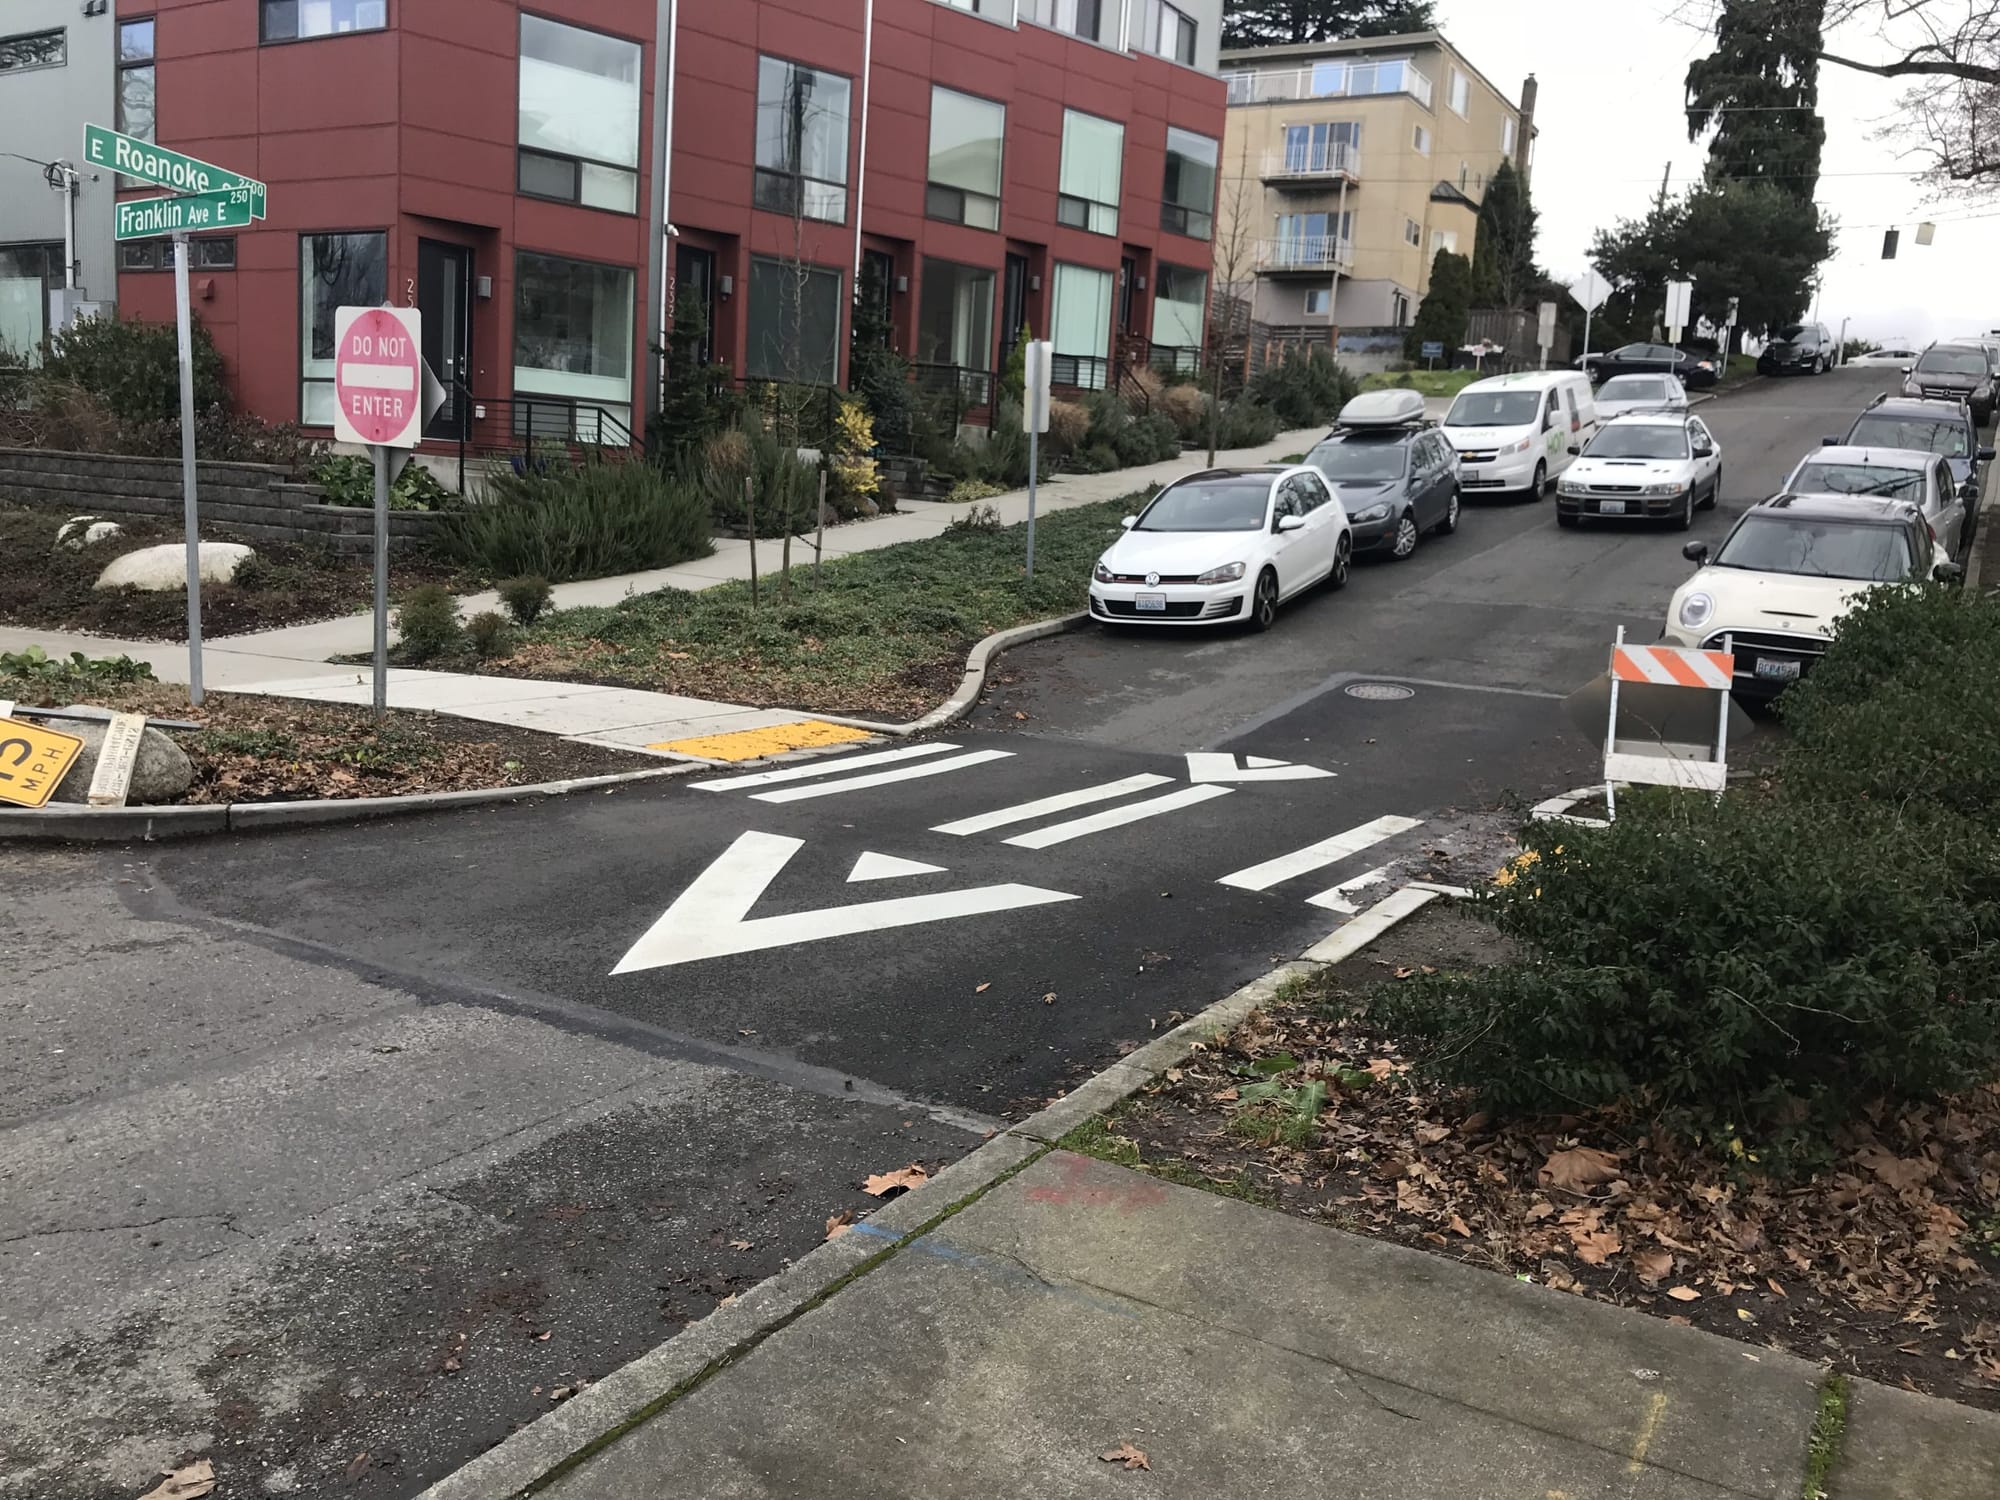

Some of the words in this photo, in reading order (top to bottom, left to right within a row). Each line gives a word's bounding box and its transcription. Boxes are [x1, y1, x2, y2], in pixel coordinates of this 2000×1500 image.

[91, 137, 104, 160] E
[115, 136, 209, 194] Roanoke
[230, 190, 248, 204] 250
[120, 199, 182, 234] Franklin
[187, 208, 209, 225] Ave
[217, 201, 227, 221] E
[352, 335, 372, 356] DO
[378, 335, 407, 358] NOT
[352, 394, 403, 418] ENTER
